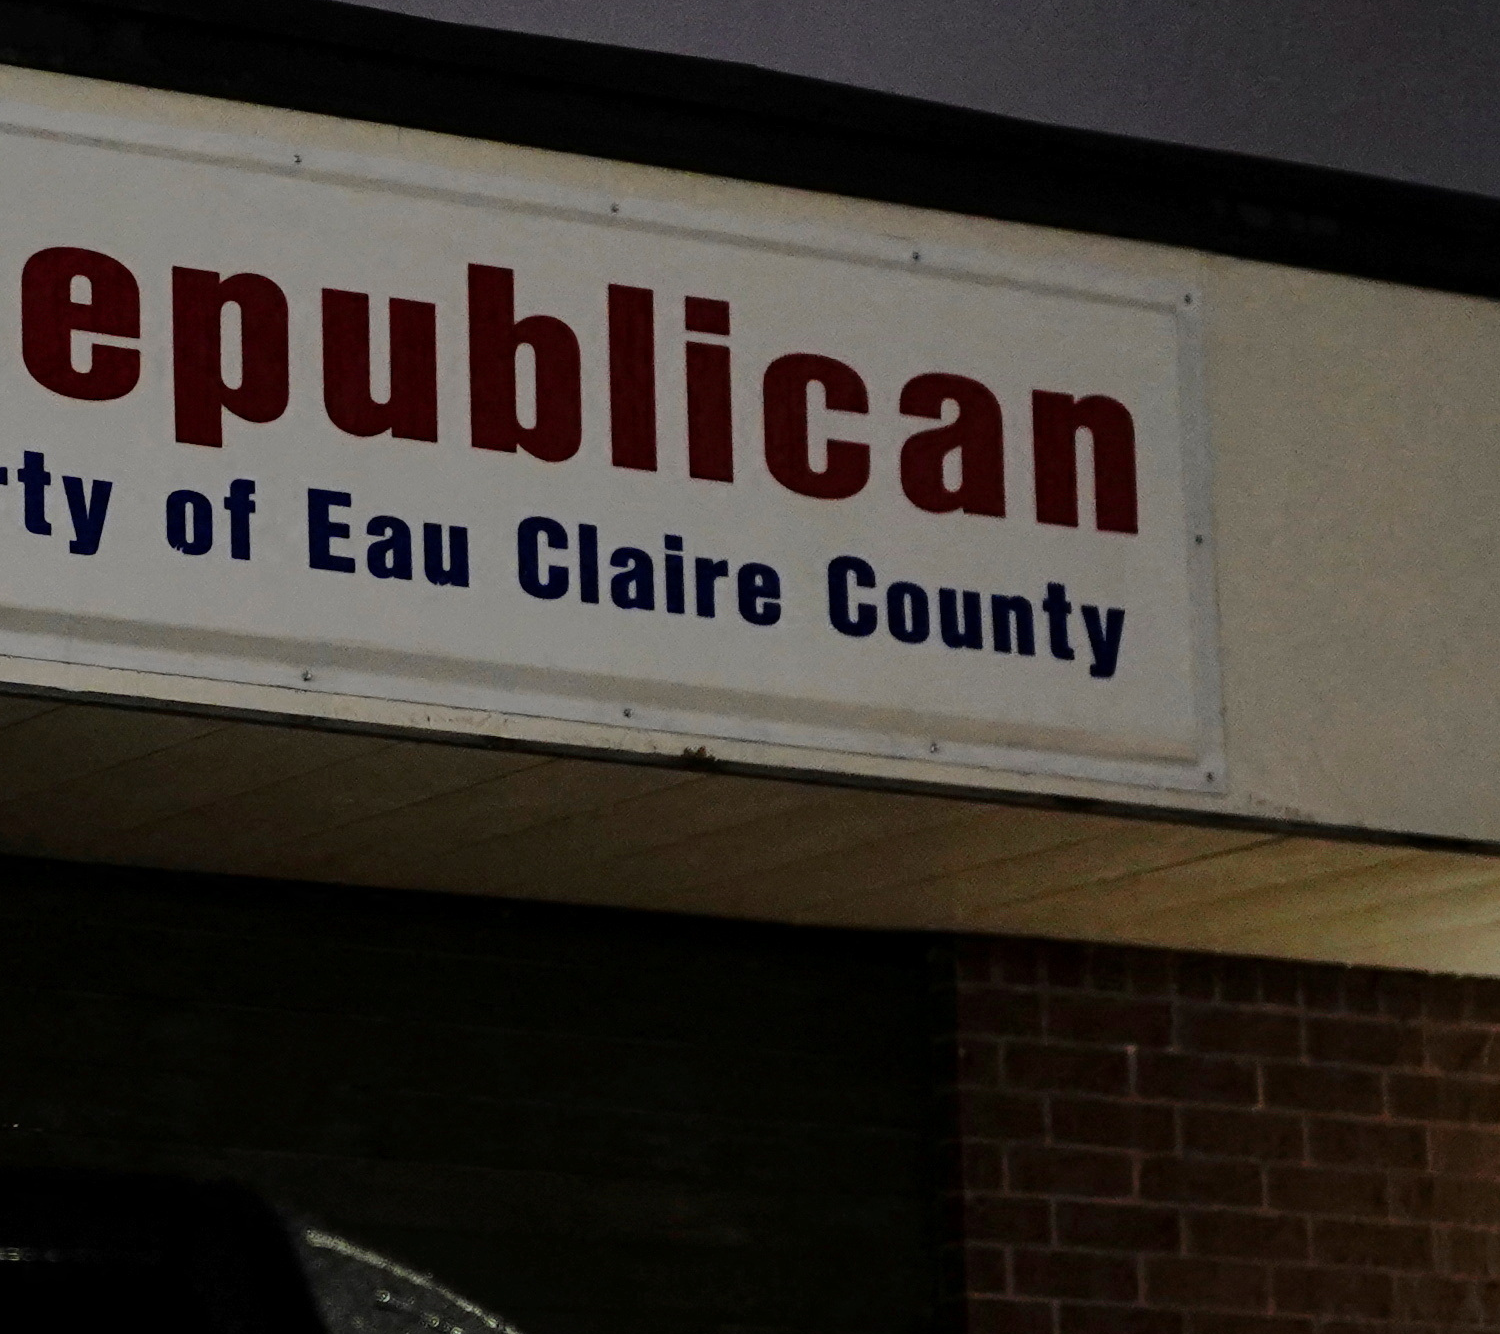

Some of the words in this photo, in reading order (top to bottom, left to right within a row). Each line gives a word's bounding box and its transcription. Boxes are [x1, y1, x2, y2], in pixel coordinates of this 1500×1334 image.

[166, 478, 256, 558] of
[307, 487, 471, 589] Eau
[516, 517, 782, 626] Claire
[827, 555, 1126, 678] County
